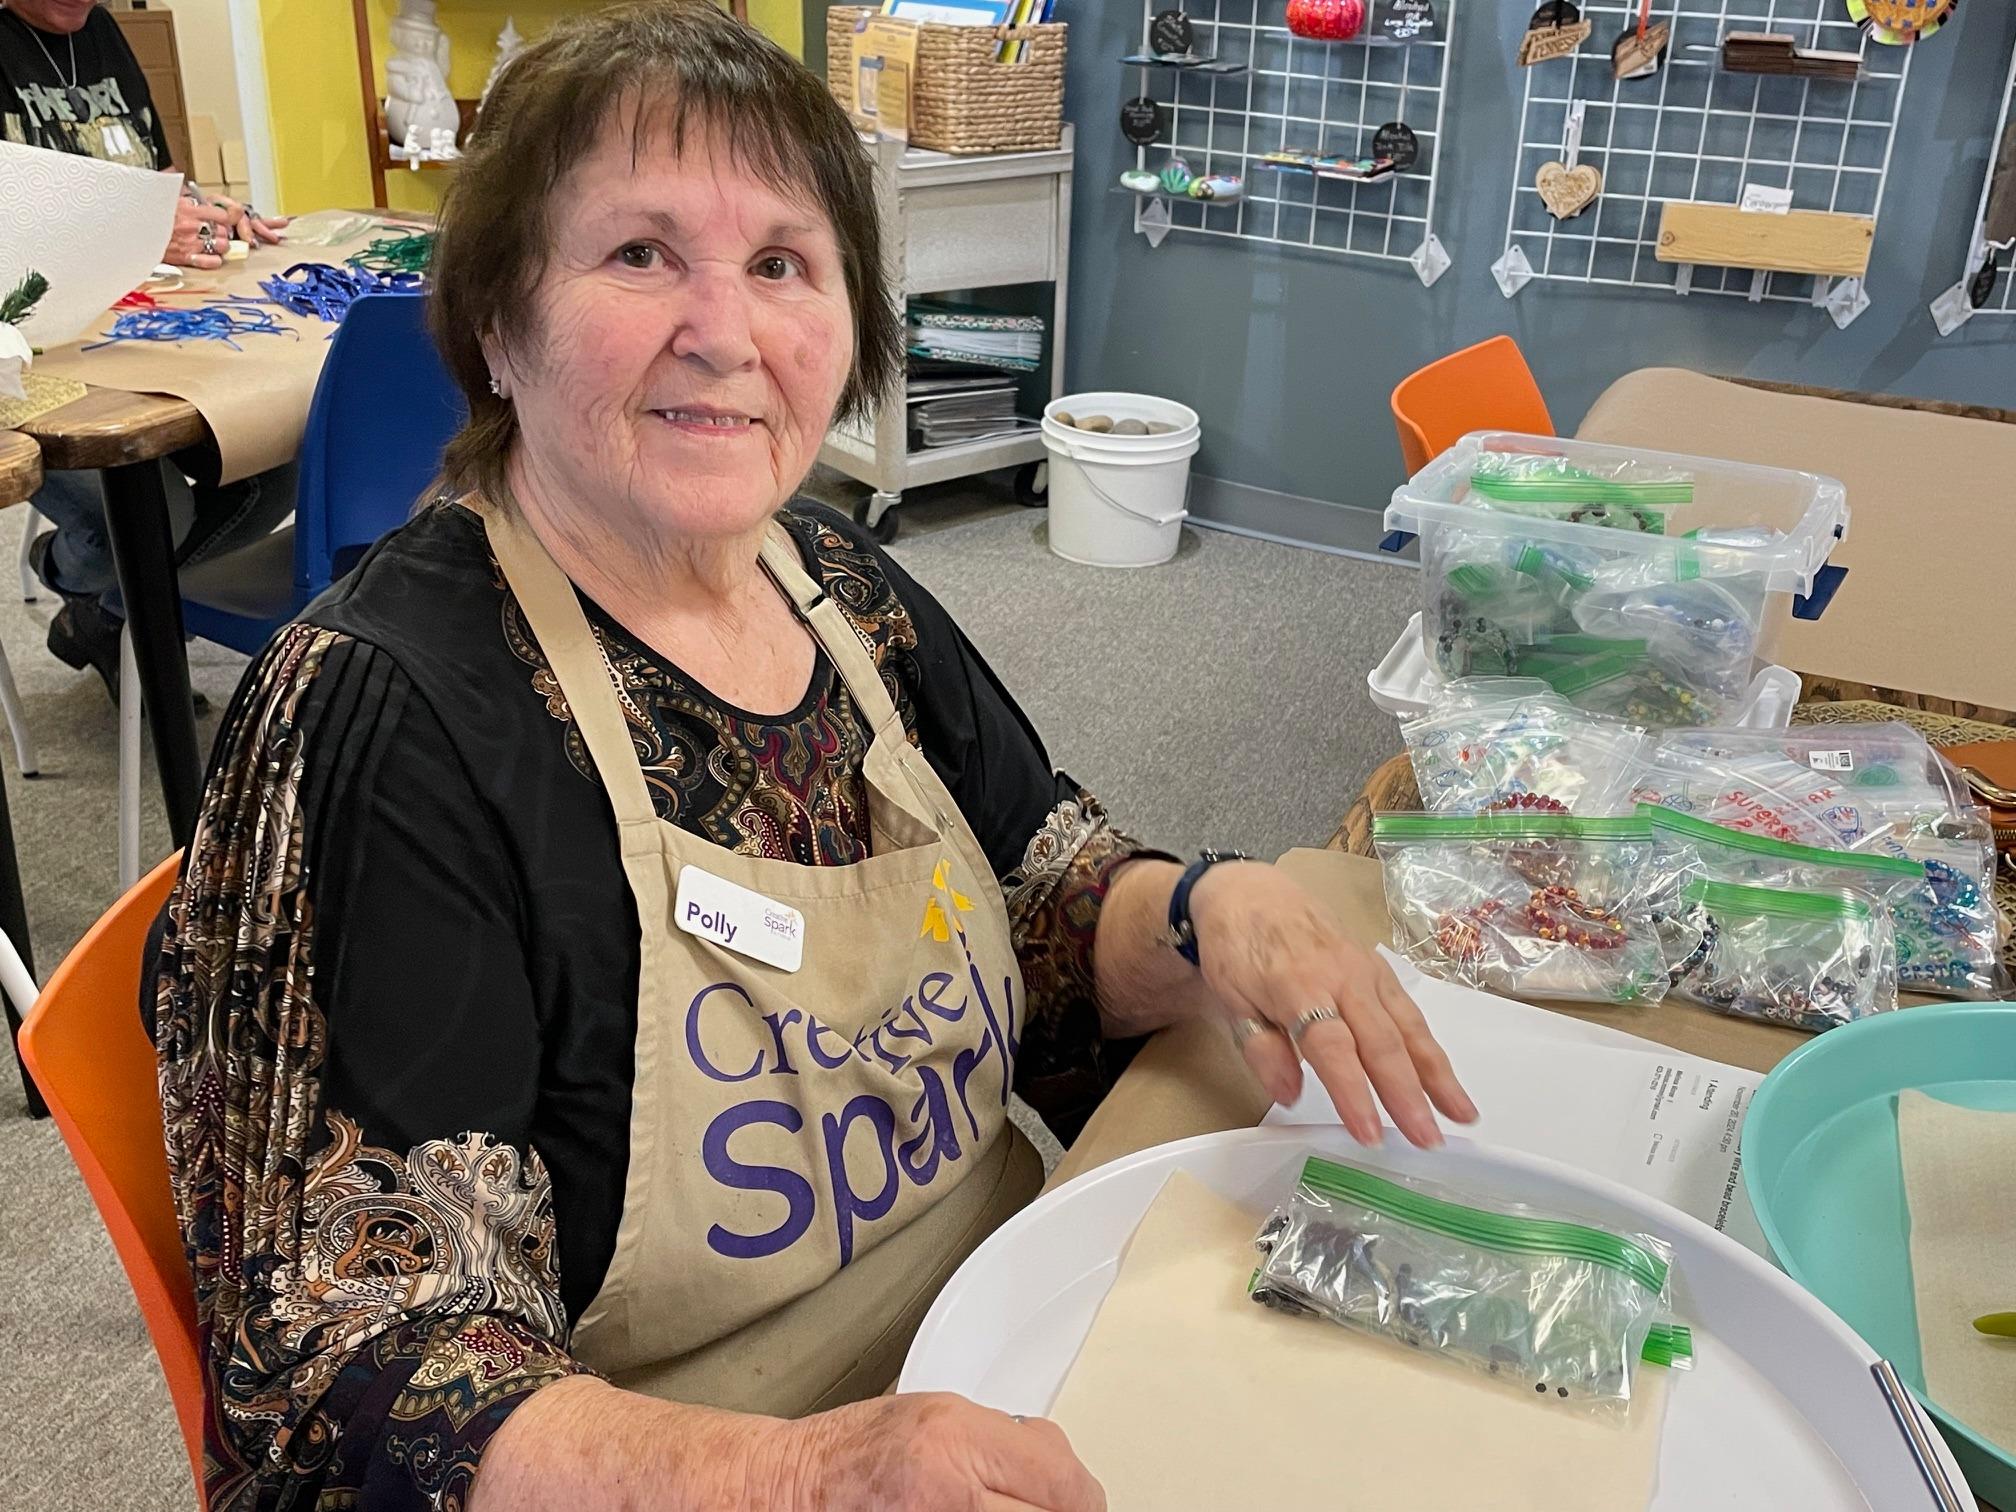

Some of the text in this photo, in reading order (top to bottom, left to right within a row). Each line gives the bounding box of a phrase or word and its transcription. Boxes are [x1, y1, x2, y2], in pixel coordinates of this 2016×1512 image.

[687, 901, 738, 943] Polly
[685, 972, 968, 1082] Cretive
[1699, 1083, 1718, 1111] Attending
[1732, 1086, 1747, 1110] November
[1726, 1118, 1737, 1131] 2024
[1728, 1171, 1738, 1185] and
[1723, 1184, 1736, 1201] bead
